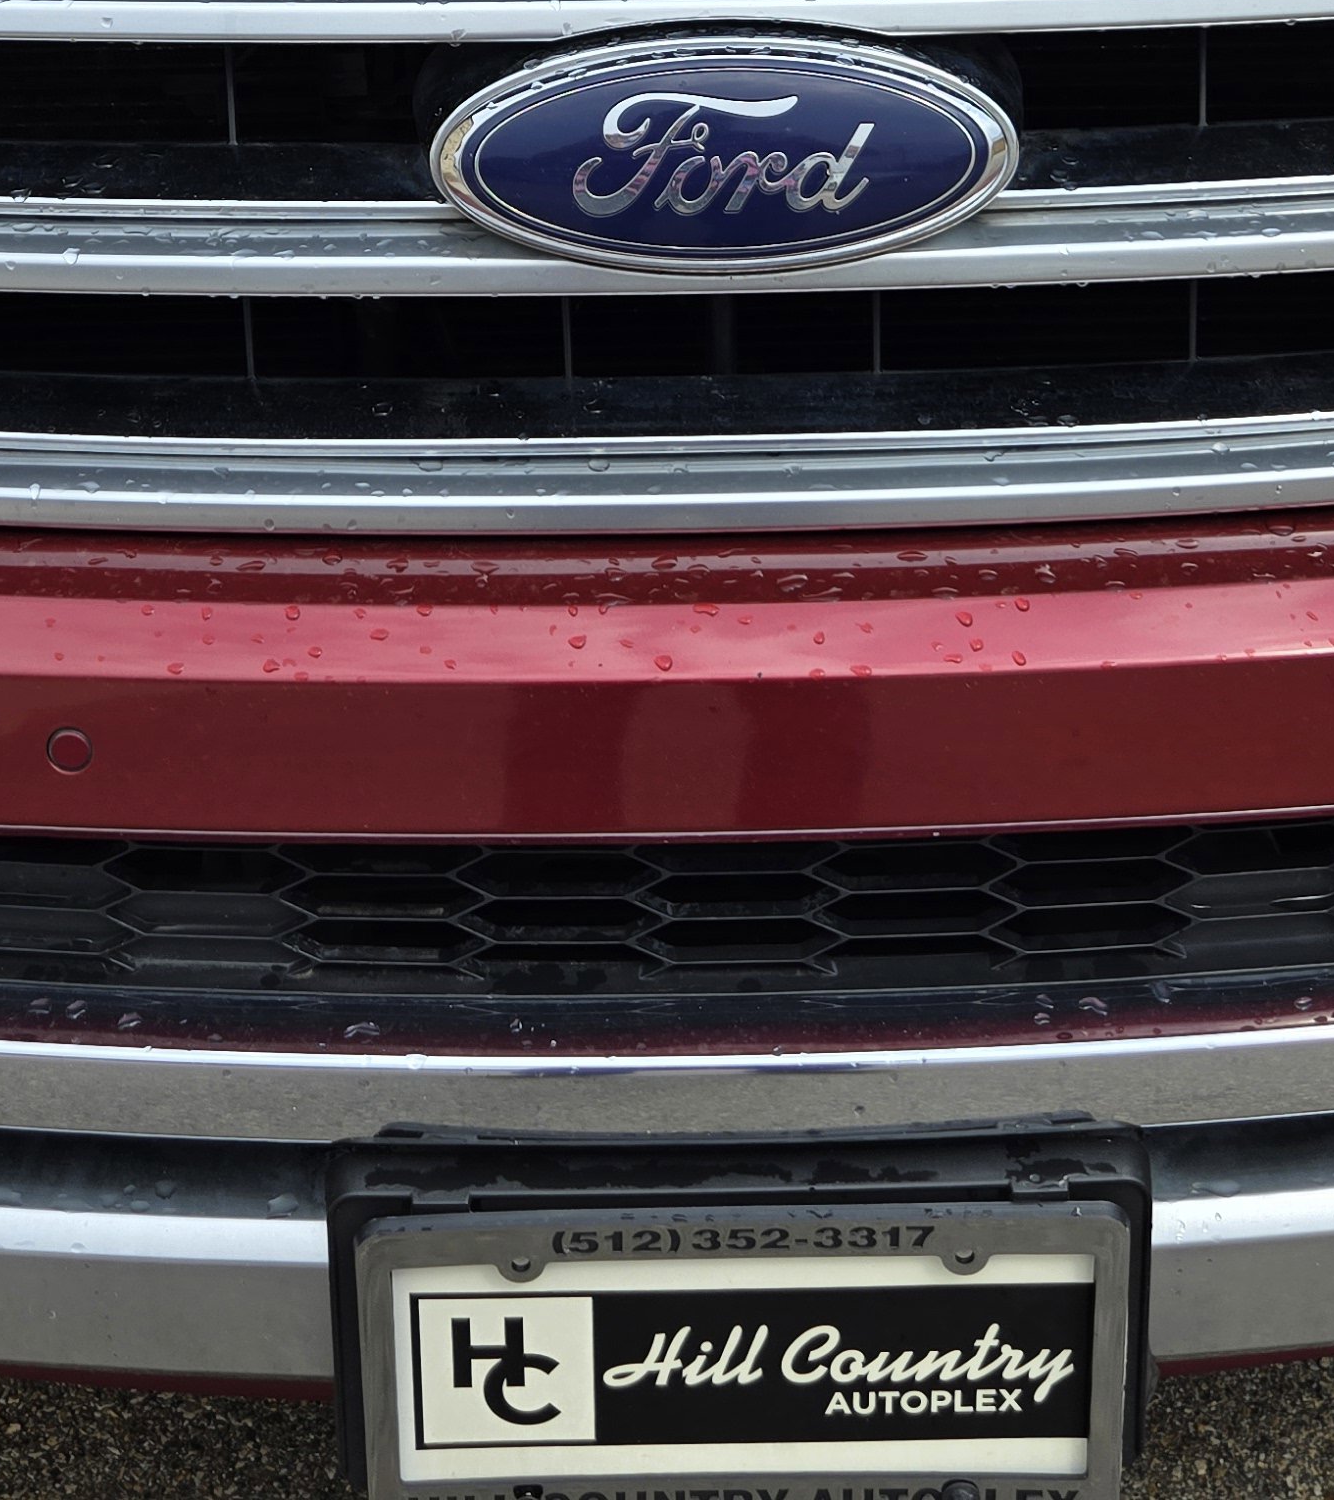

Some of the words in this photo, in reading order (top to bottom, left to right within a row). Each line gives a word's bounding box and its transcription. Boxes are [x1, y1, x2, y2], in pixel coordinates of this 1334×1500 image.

[572, 91, 875, 217] Ford
[602, 1324, 768, 1389] Hill
[780, 1322, 1074, 1403] Country
[823, 1388, 1024, 1416] AUTOPLEX
